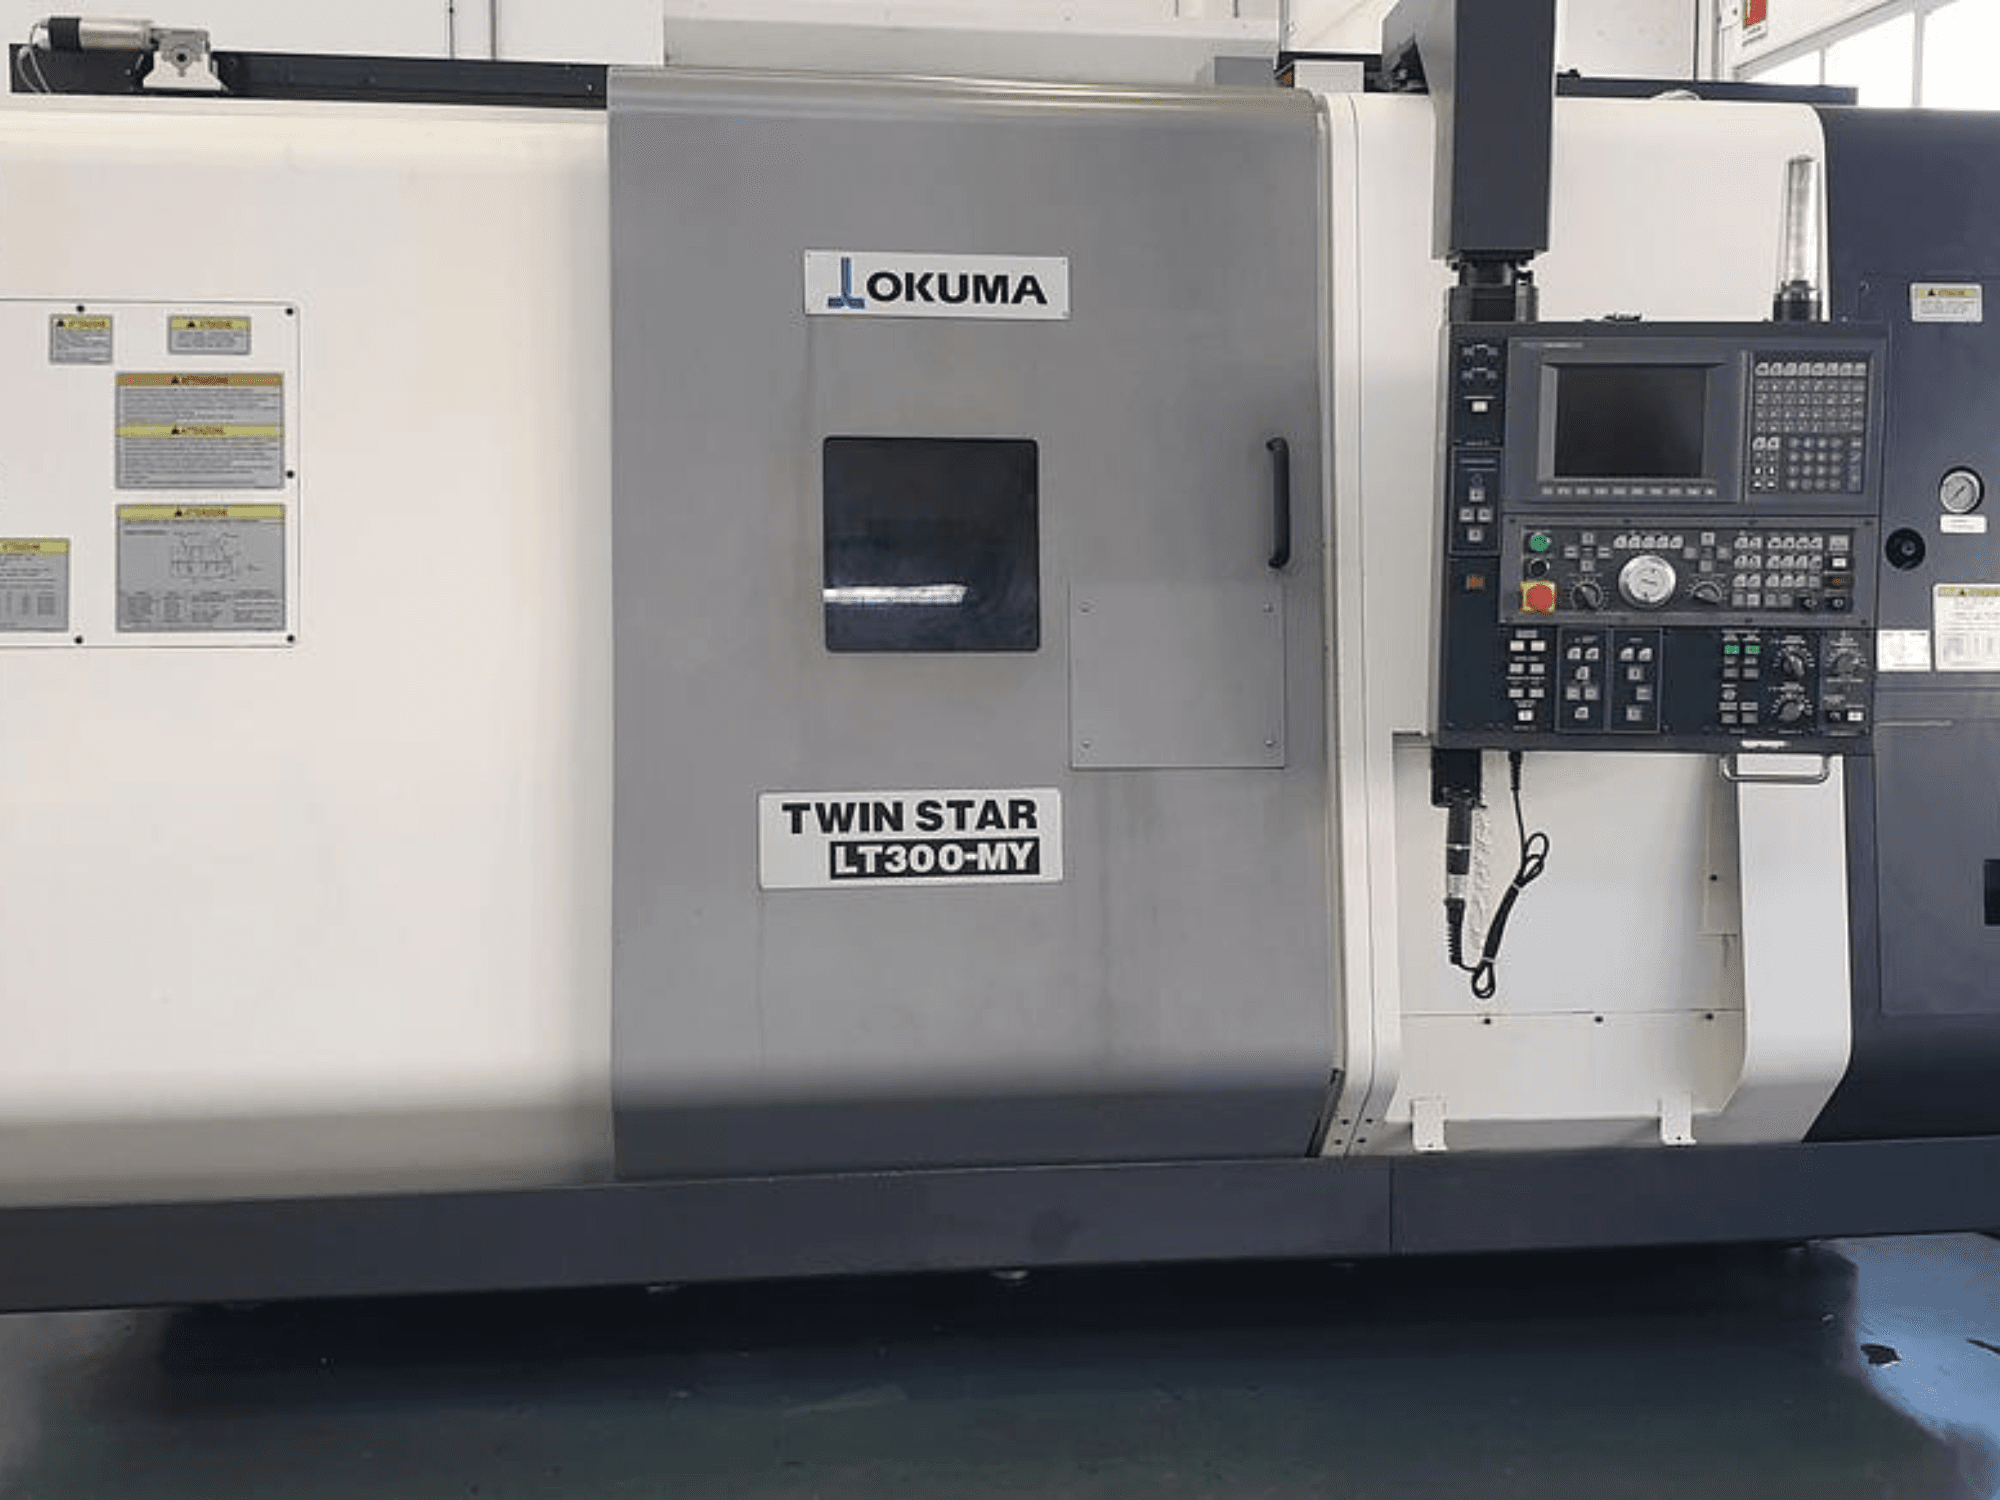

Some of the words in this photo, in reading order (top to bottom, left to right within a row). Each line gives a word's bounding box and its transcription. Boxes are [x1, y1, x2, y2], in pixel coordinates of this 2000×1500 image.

[866, 271, 1048, 305] OKUMA
[781, 802, 904, 834] TWIN
[915, 799, 1038, 832] STAR
[834, 841, 1035, 874] LT300-MY
